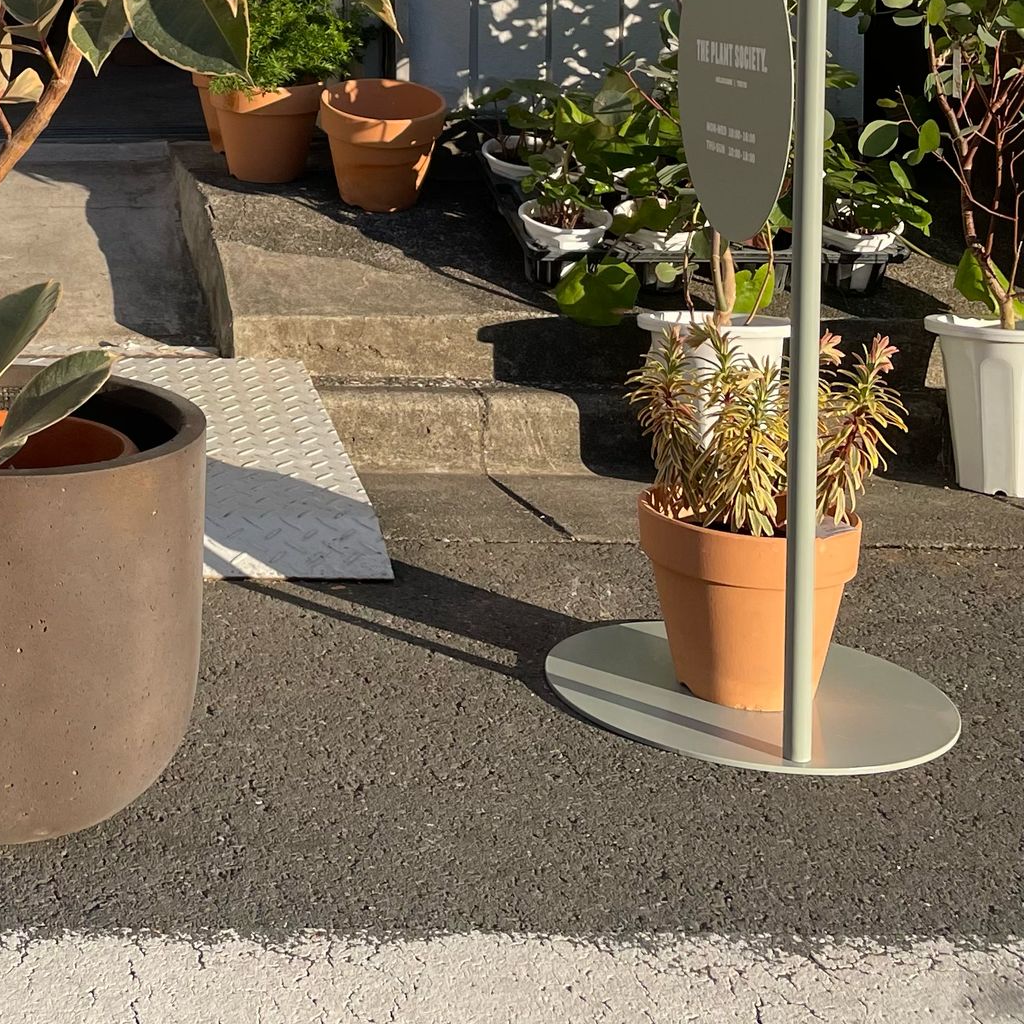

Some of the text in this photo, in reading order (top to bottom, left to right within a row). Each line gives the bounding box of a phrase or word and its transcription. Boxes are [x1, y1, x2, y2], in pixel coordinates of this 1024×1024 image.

[696, 39, 768, 73] THE PLANT SOCIETY.
